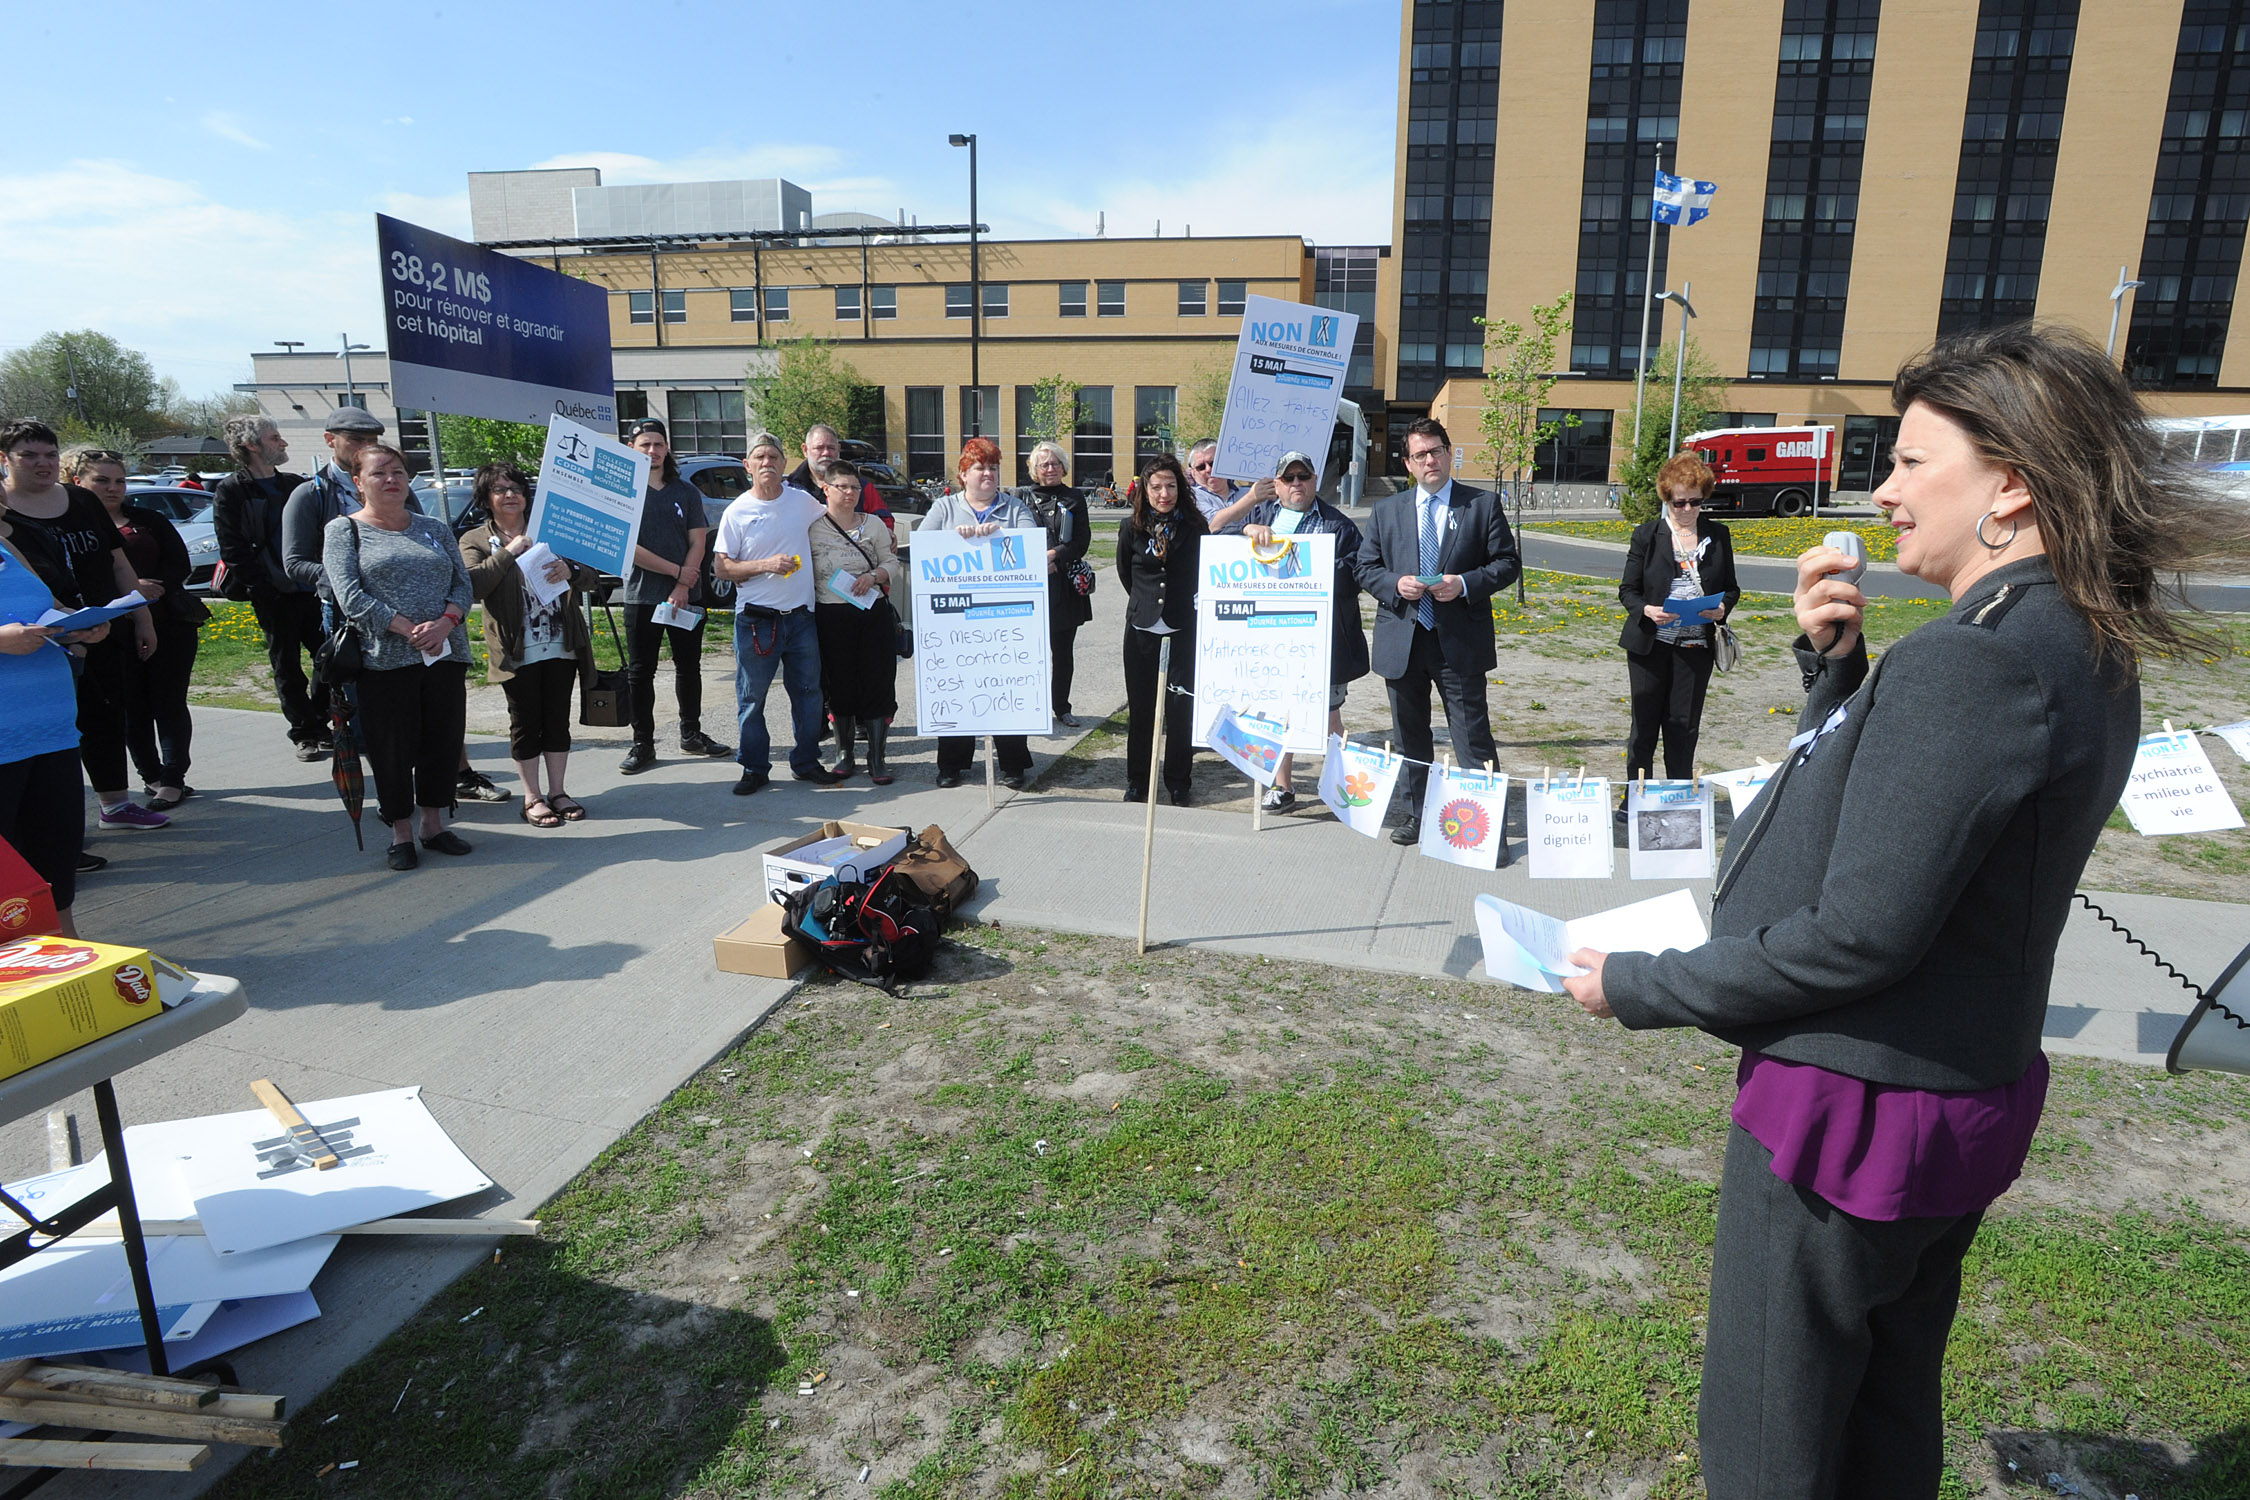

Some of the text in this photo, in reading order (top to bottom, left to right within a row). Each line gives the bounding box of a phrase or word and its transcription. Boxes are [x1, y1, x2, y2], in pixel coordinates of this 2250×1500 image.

[391, 250, 492, 306] 38,2 M$
[394, 289, 564, 341] pour rénover et agrandir
[396, 314, 482, 345] cet hôpital
[1251, 322, 1302, 342] NON
[1255, 339, 1268, 347] AUX
[1269, 341, 1297, 351] MESURES
[1297, 346, 1306, 354] DE
[1307, 347, 1338, 359] CONTRÔLE
[1253, 358, 1283, 371] 15 MAI
[555, 399, 597, 420] Québec
[1776, 441, 1813, 458] GARD
[556, 459, 585, 475] CDDM
[596, 463, 631, 482] DES DROITS
[605, 460, 632, 477] DÉFENSE
[552, 468, 584, 484] ENSEMBLE
[594, 475, 630, 493] MONTÉRÉGIE
[565, 508, 594, 524] PROMOTION
[605, 524, 625, 536] RESPECT
[921, 550, 984, 580] NON
[947, 575, 980, 583] MESURES
[982, 574, 993, 582] DE
[994, 573, 1033, 582] CONTRÔLE
[1279, 581, 1318, 590] CONTRÔLE
[933, 596, 970, 608] 15 MAI
[1218, 604, 1254, 614] 15 MAI
[967, 605, 1031, 617] JOURNÉE NATIONALE
[1249, 615, 1313, 626] JOURNÉE NATIONALE
[956, 645, 1032, 667] contrôle
[975, 670, 1042, 689] vraiment
[1249, 721, 1270, 731] NON
[2141, 744, 2170, 758] NON
[1355, 756, 1377, 765] NON
[2131, 765, 2203, 782] sychiatrie
[1460, 782, 1482, 791] NON
[2144, 788, 2190, 800] milieu
[2195, 784, 2214, 794] de
[1557, 791, 1581, 801] NON
[1660, 791, 1685, 803] NON
[1545, 812, 1589, 824] Pour la
[2170, 807, 2194, 816] vie
[1543, 833, 1591, 847] dignité!
[32, 1320, 88, 1336] SANTÉ
[89, 1313, 143, 1328] MENTA
